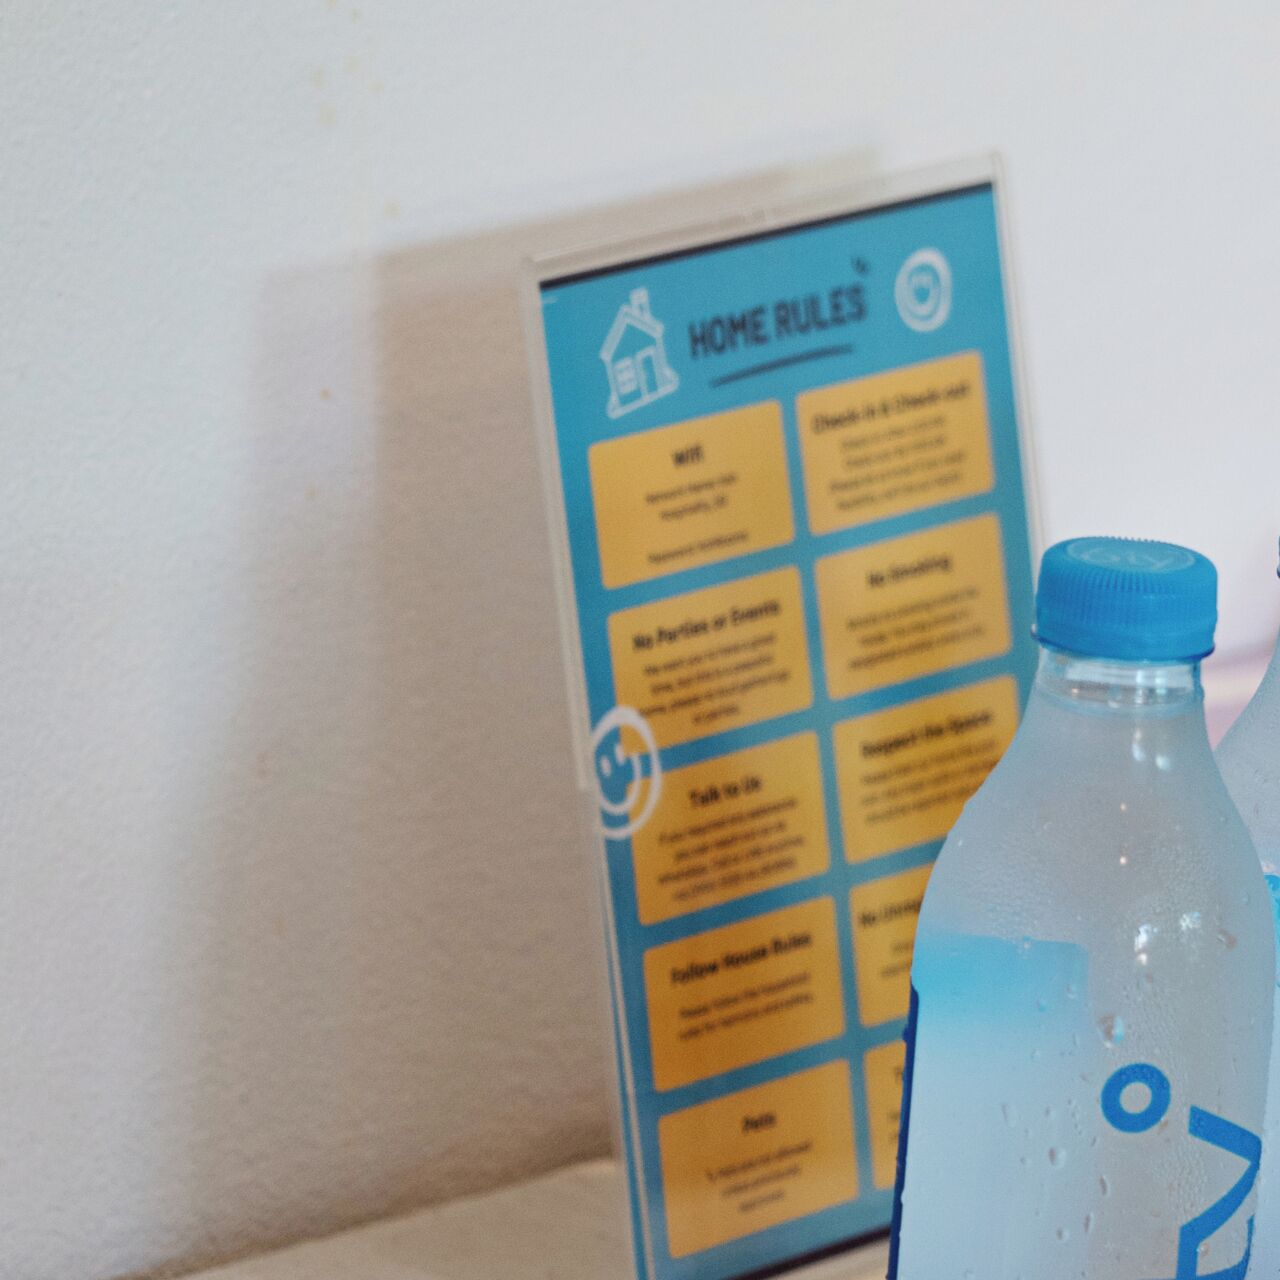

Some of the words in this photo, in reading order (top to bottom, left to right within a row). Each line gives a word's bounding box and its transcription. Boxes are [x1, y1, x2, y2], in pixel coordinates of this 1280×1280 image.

[688, 304, 770, 361] HOME
[774, 281, 869, 340] RULES
[632, 633, 654, 651] No
[656, 618, 709, 646] Parties
[729, 599, 781, 626] Events
[688, 783, 721, 808] Talk
[670, 960, 720, 987] Follow
[722, 945, 770, 969] House
[770, 931, 813, 955] Rules
